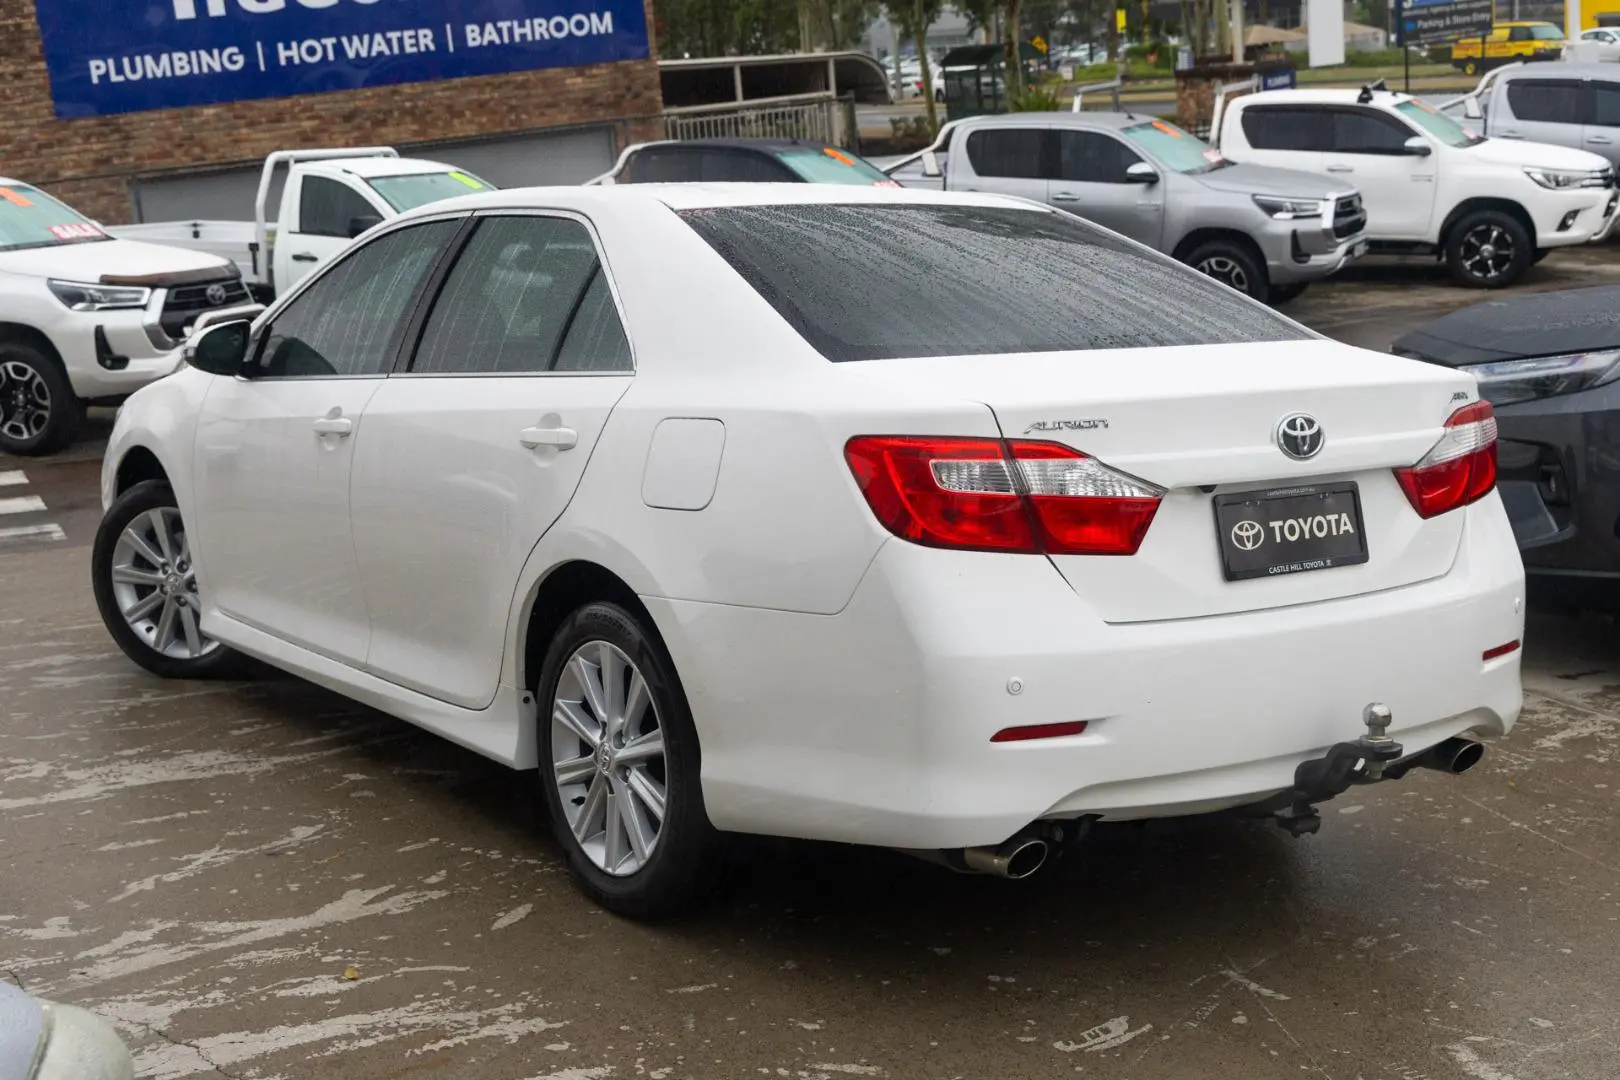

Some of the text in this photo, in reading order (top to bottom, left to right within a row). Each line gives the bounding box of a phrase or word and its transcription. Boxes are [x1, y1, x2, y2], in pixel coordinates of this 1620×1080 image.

[88, 46, 245, 85] PLUMBING
[277, 37, 338, 66] HOT
[341, 28, 436, 59] WATER
[465, 11, 614, 47] BATHROOM
[1023, 419, 1109, 434] AURION
[1269, 512, 1355, 543] TOYOTA
[1268, 560, 1325, 574] CASTLE HILL TOYOTA
